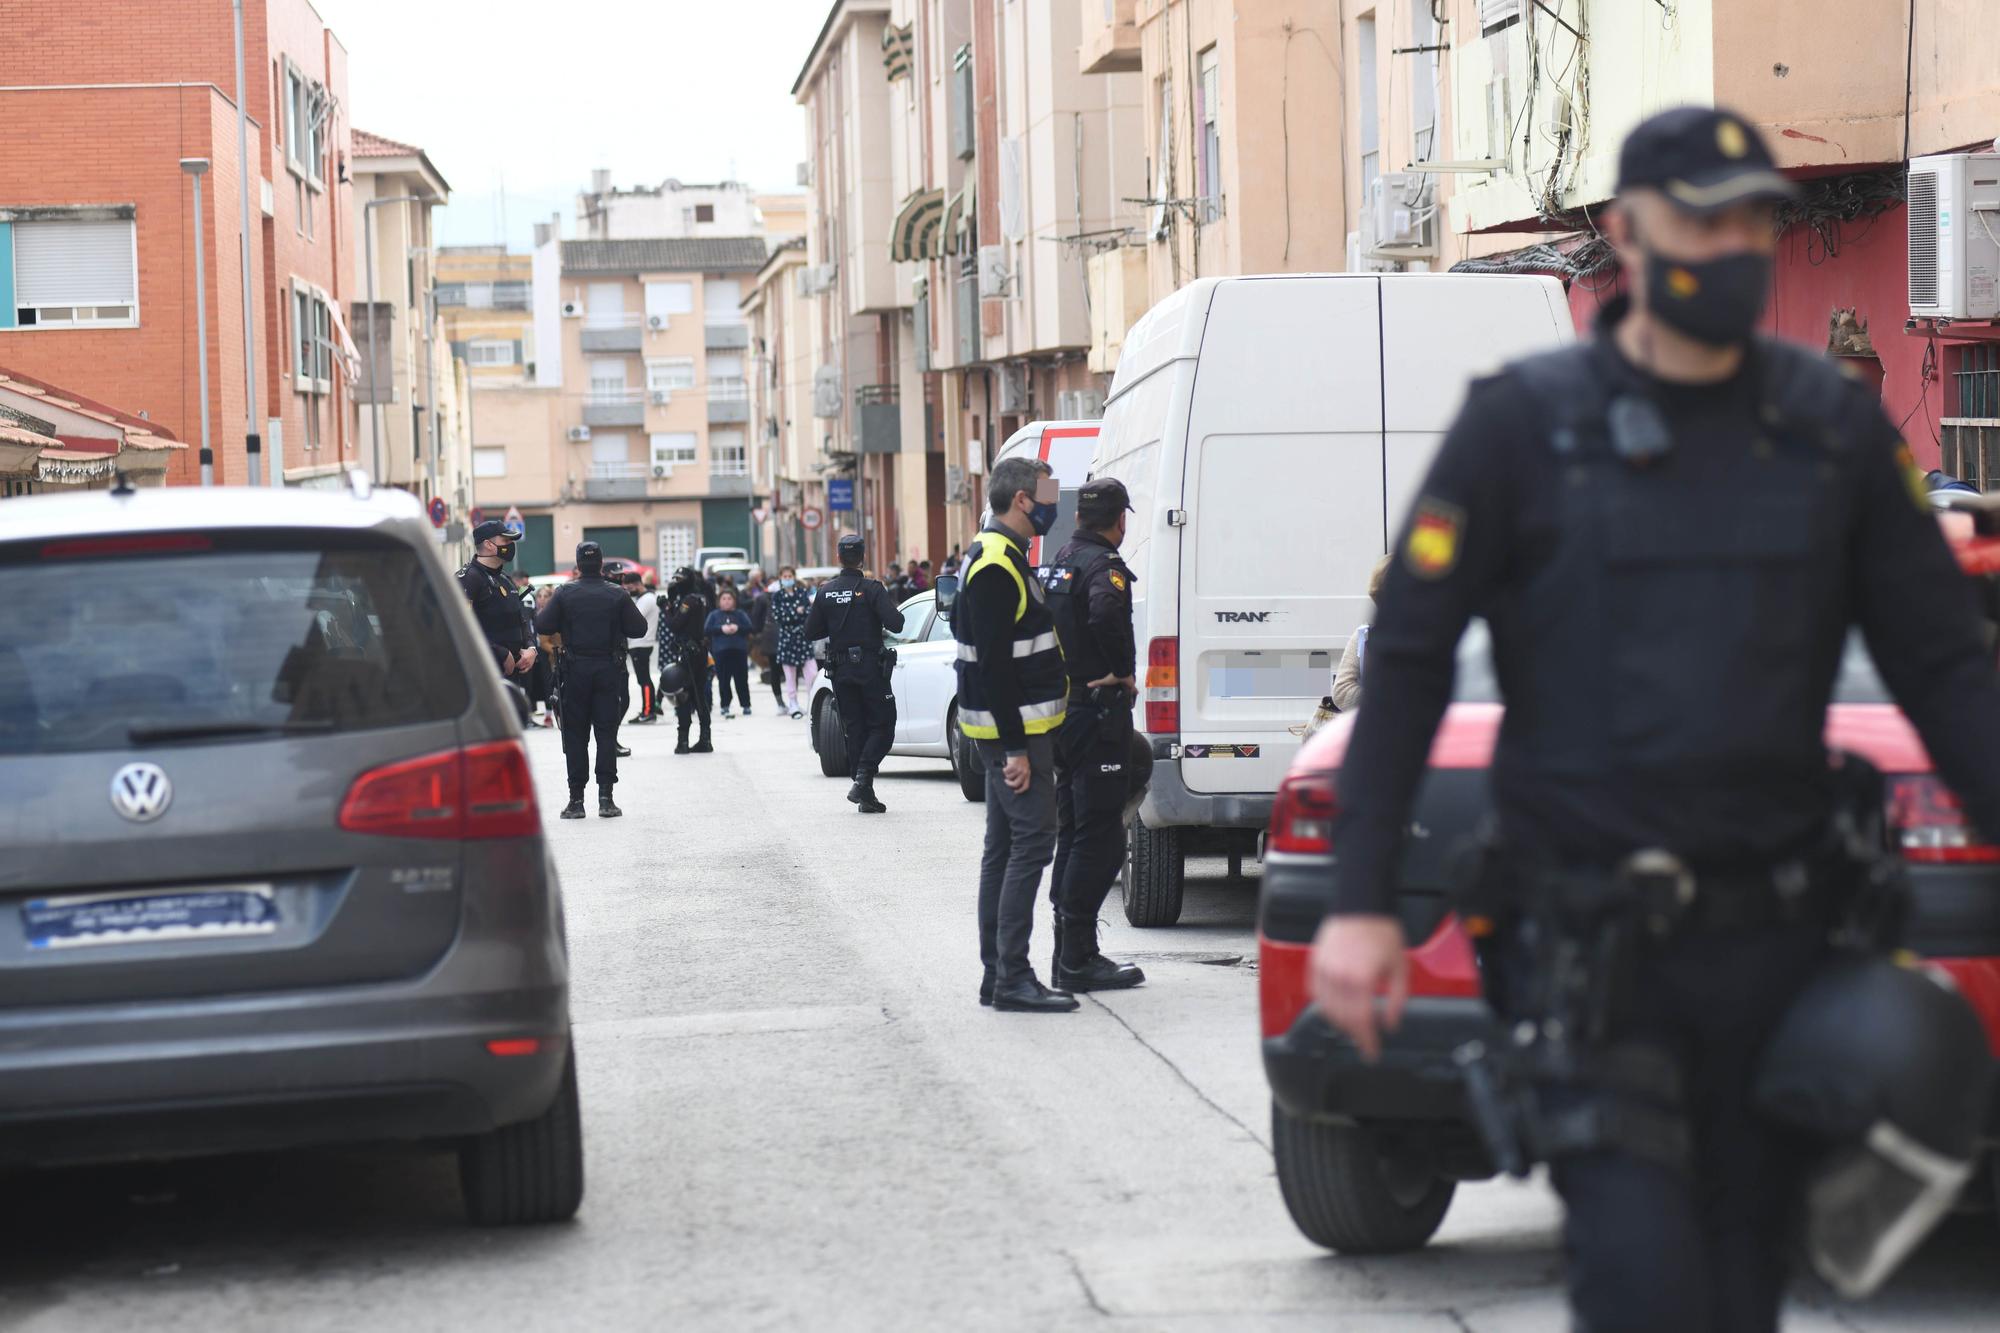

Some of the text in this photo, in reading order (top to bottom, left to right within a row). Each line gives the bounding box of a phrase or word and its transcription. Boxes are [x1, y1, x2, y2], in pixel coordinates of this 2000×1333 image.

[825, 590, 853, 599] POLICI
[1214, 611, 1288, 623] TRAN
[1100, 764, 1121, 772] CNP
